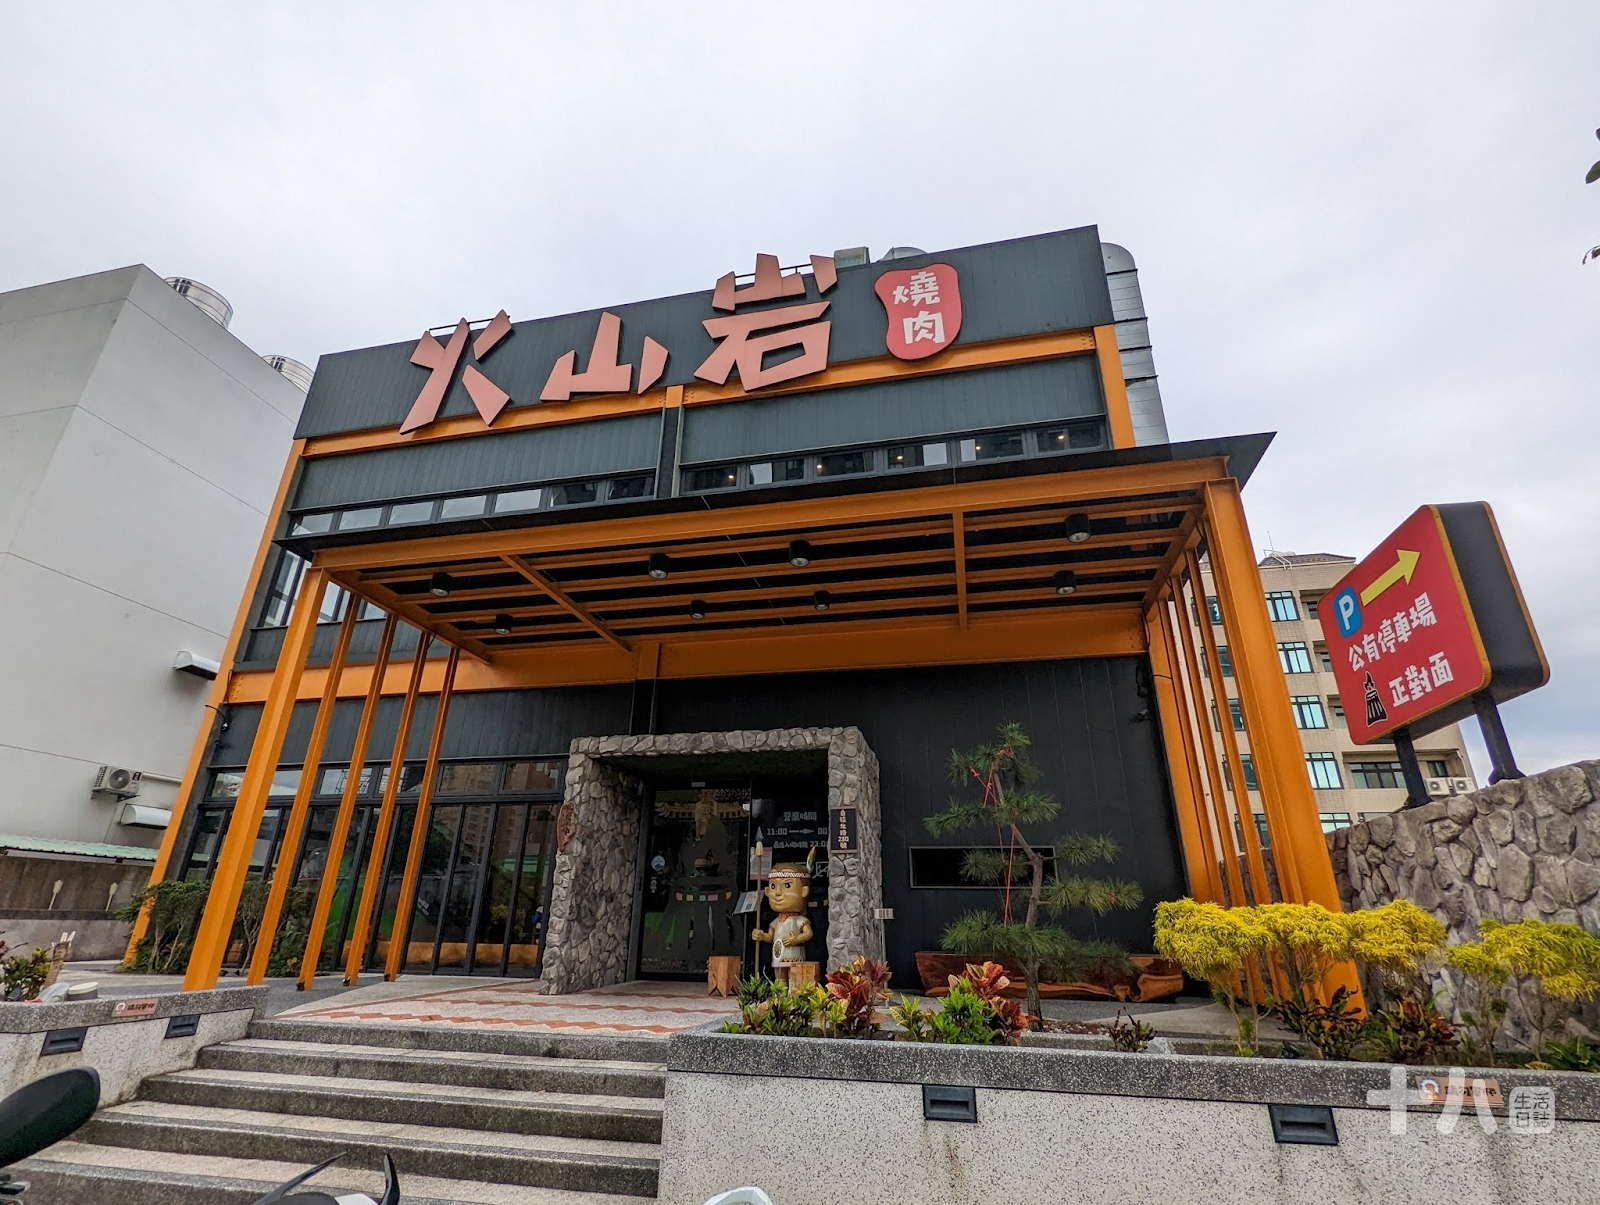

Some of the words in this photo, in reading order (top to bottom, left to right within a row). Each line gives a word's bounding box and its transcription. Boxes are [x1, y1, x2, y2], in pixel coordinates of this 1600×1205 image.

[892, 271, 946, 345] 燒肉
[399, 253, 836, 434] 火山岩
[1339, 594, 1354, 630] P
[1348, 591, 1437, 672] 公有停車場
[1388, 651, 1454, 708] 正對面
[766, 828, 788, 836] 11:00
